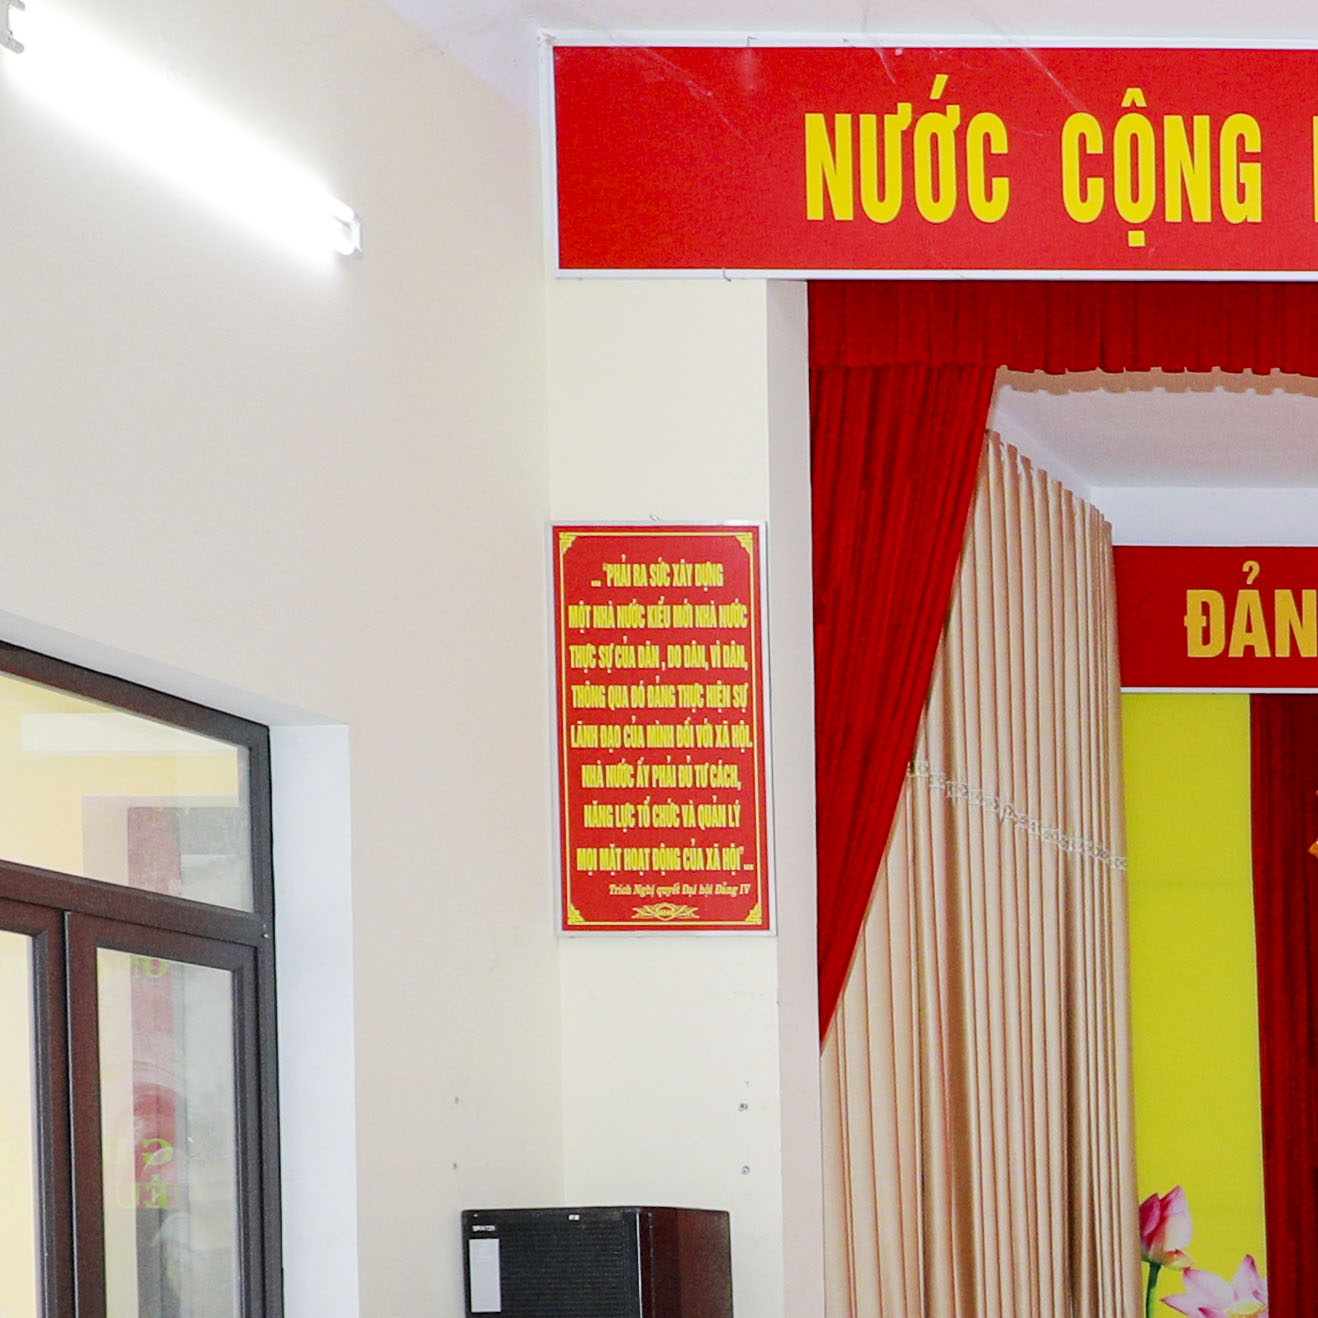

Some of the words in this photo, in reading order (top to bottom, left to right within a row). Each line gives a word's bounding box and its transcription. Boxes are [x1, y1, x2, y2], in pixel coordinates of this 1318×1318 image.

[805, 74, 1009, 223] NƯỚC
[1062, 88, 1261, 246] CỘNG
[633, 563, 647, 587] RA
[650, 556, 670, 588] SỨC
[672, 558, 692, 587] XÂY
[568, 600, 590, 634] MỘT
[615, 635, 635, 669] CỦA
[668, 644, 681, 669] DO
[608, 684, 628, 711] QUA
[624, 715, 645, 749] CỦA
[682, 799, 696, 828] VÀ
[729, 799, 740, 828] LÝ
[683, 837, 704, 871] CỦA
